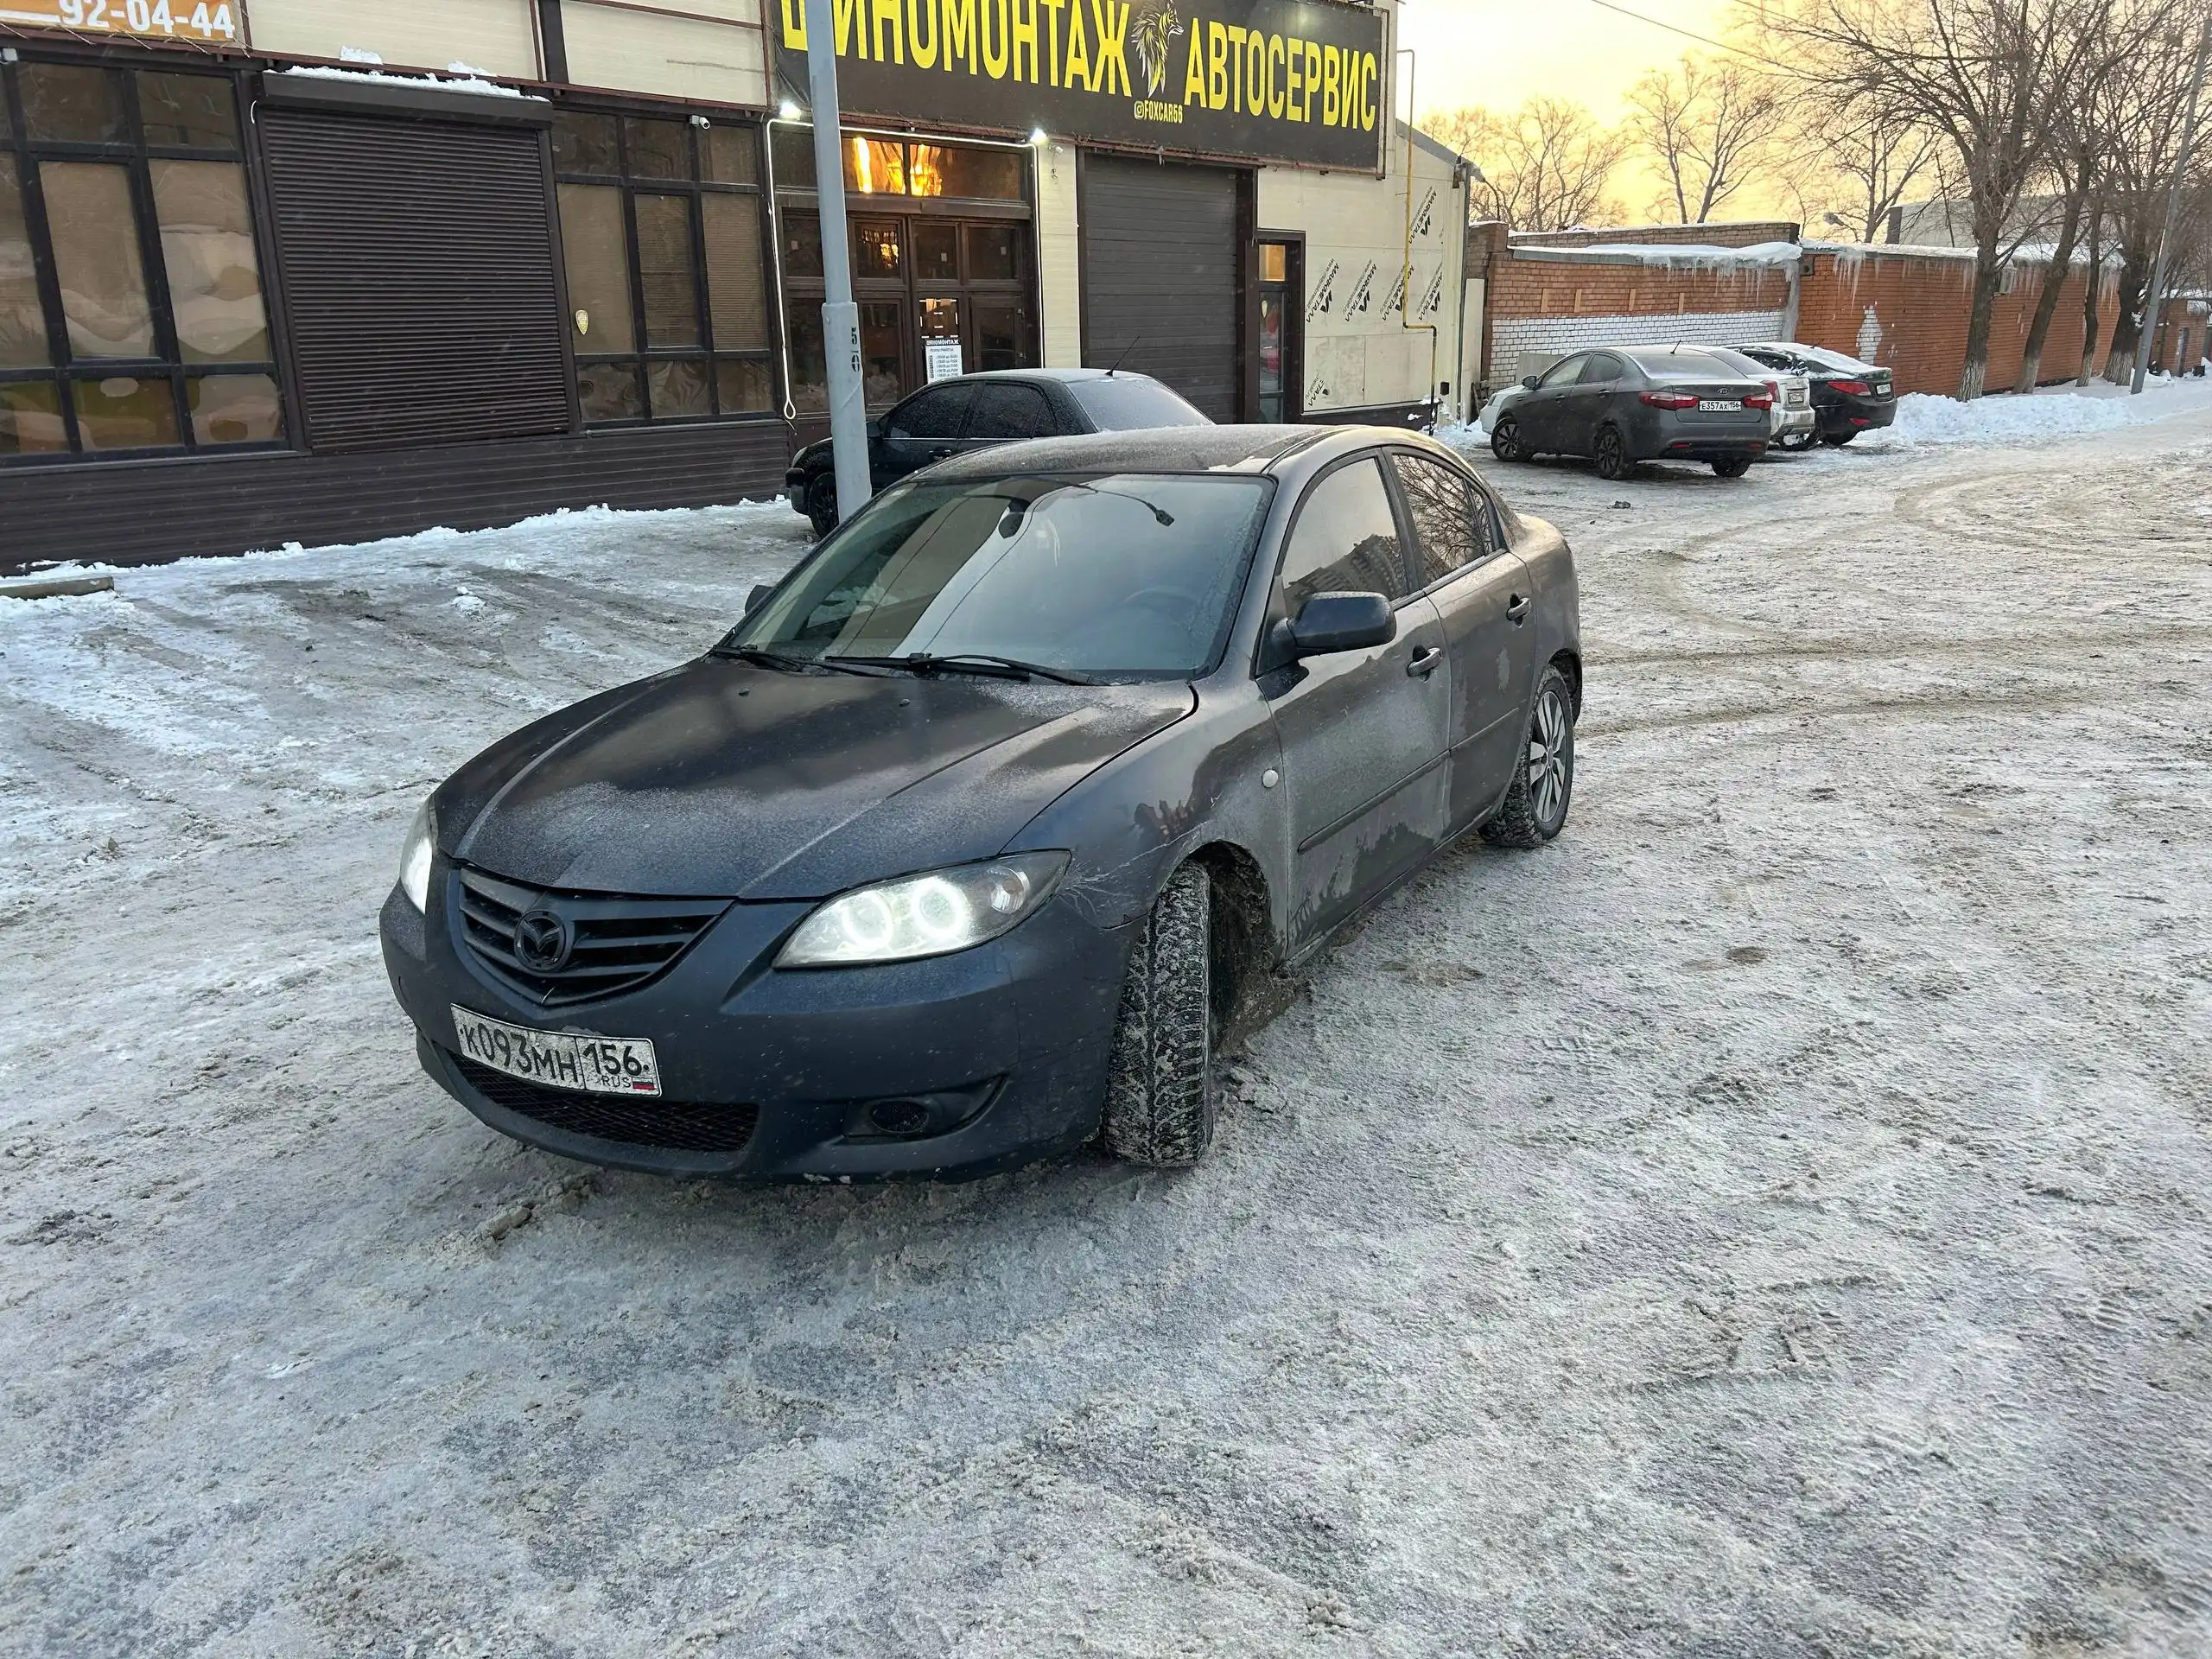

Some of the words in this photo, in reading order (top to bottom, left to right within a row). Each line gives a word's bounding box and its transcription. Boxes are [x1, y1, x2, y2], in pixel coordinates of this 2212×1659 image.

[60, 0, 235, 39] 92-04-44
[1184, 18, 1377, 132] АВТОСЕРВИС
[462, 1022, 579, 1083] К093МН
[582, 1042, 643, 1077] 156
[601, 1075, 632, 1088] RUS
